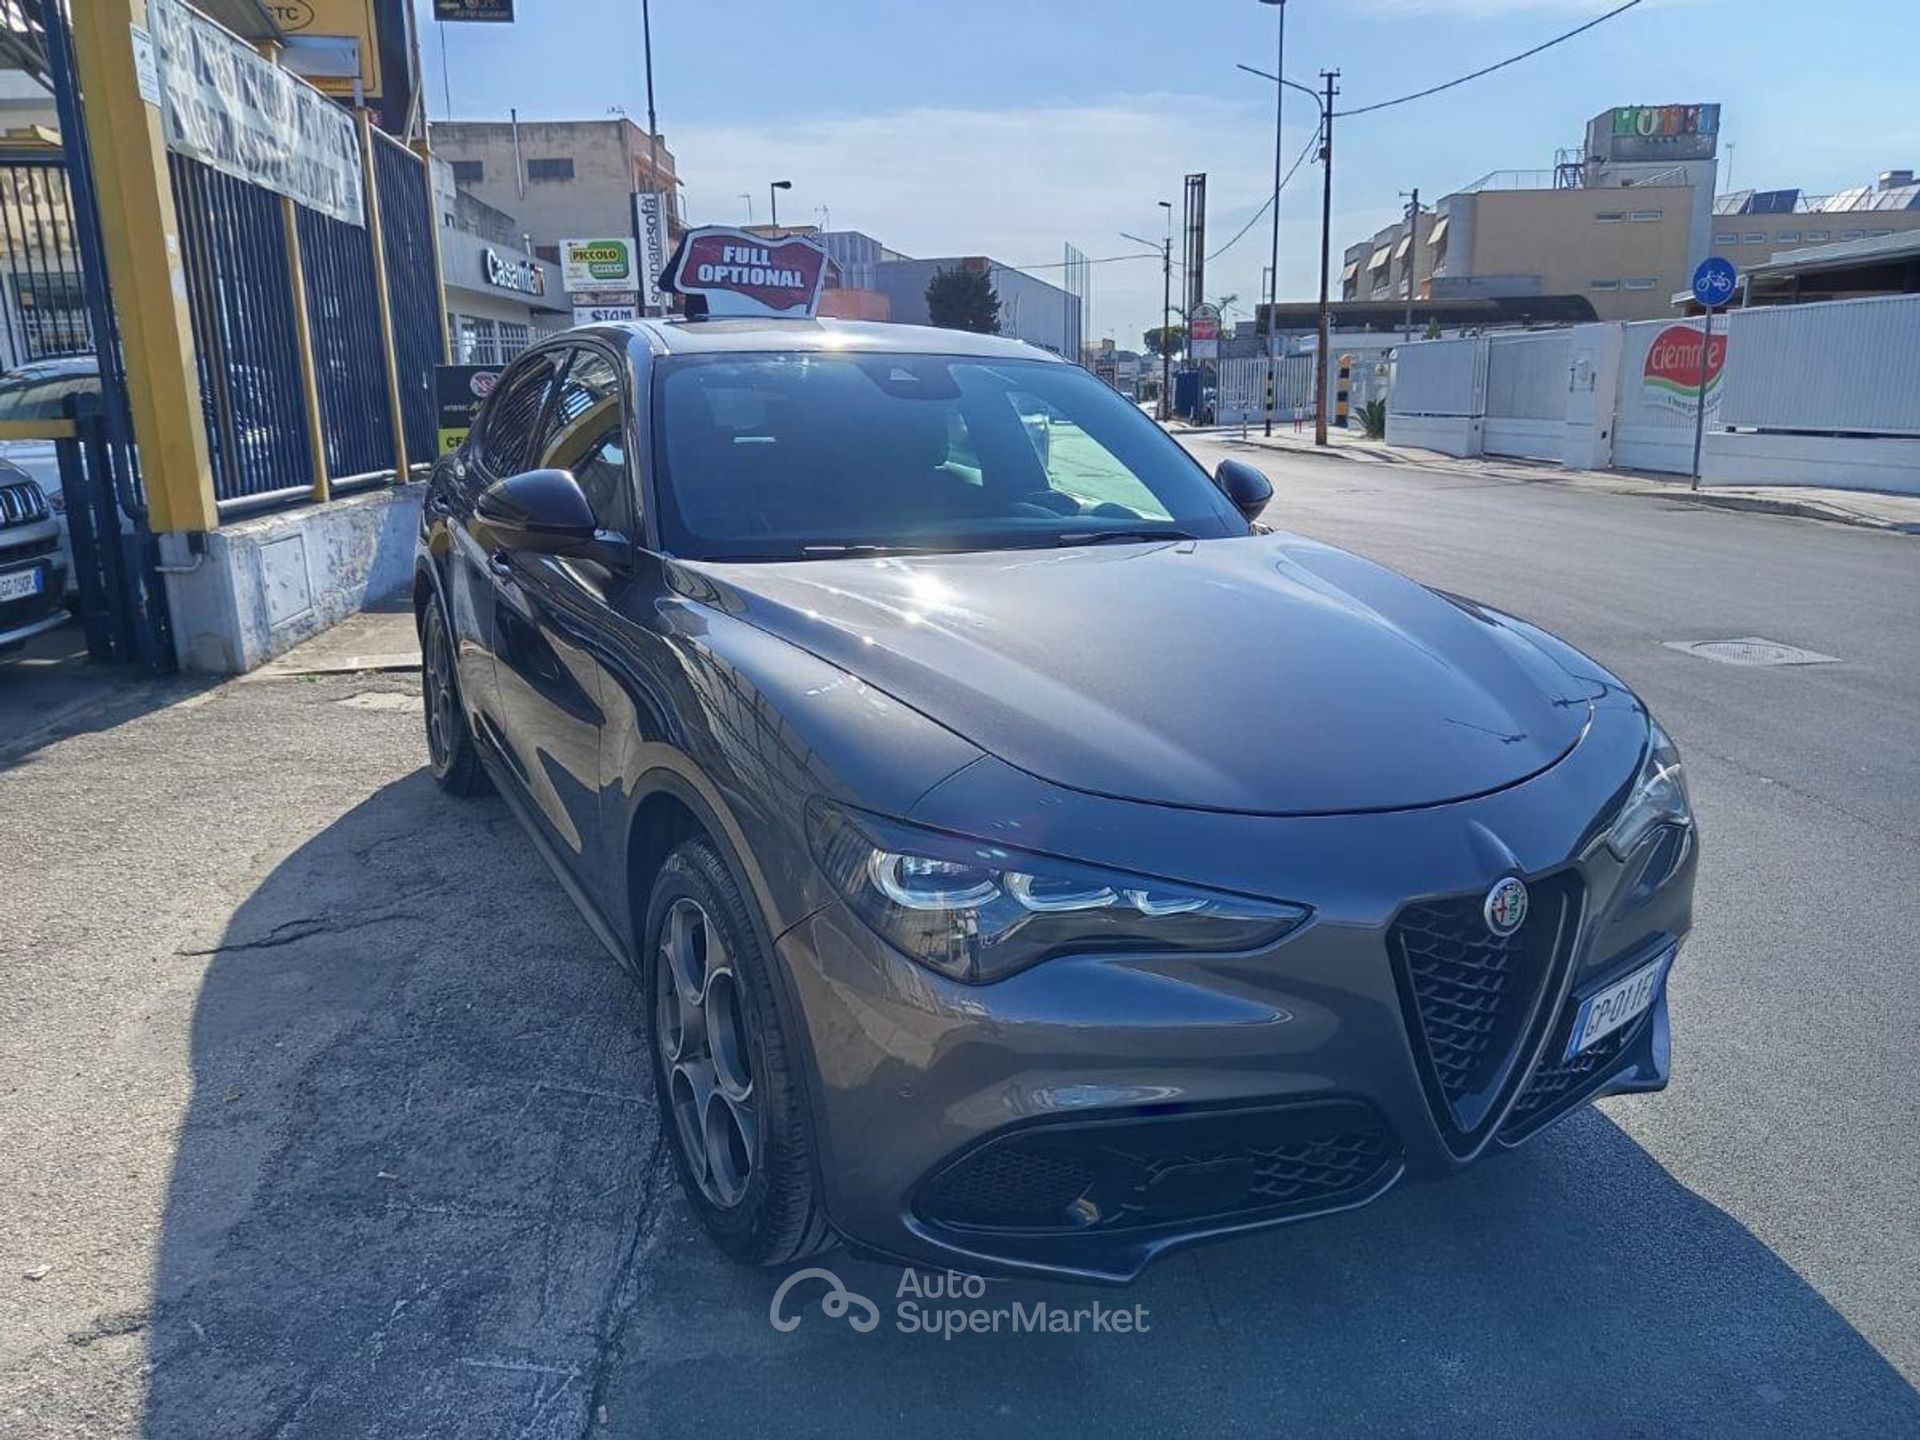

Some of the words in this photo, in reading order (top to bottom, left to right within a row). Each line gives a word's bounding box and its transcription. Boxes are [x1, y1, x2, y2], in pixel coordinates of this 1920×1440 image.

[572, 249, 618, 261] PICCOLO
[722, 246, 771, 266] FULL
[697, 264, 804, 287] OPTIONAL
